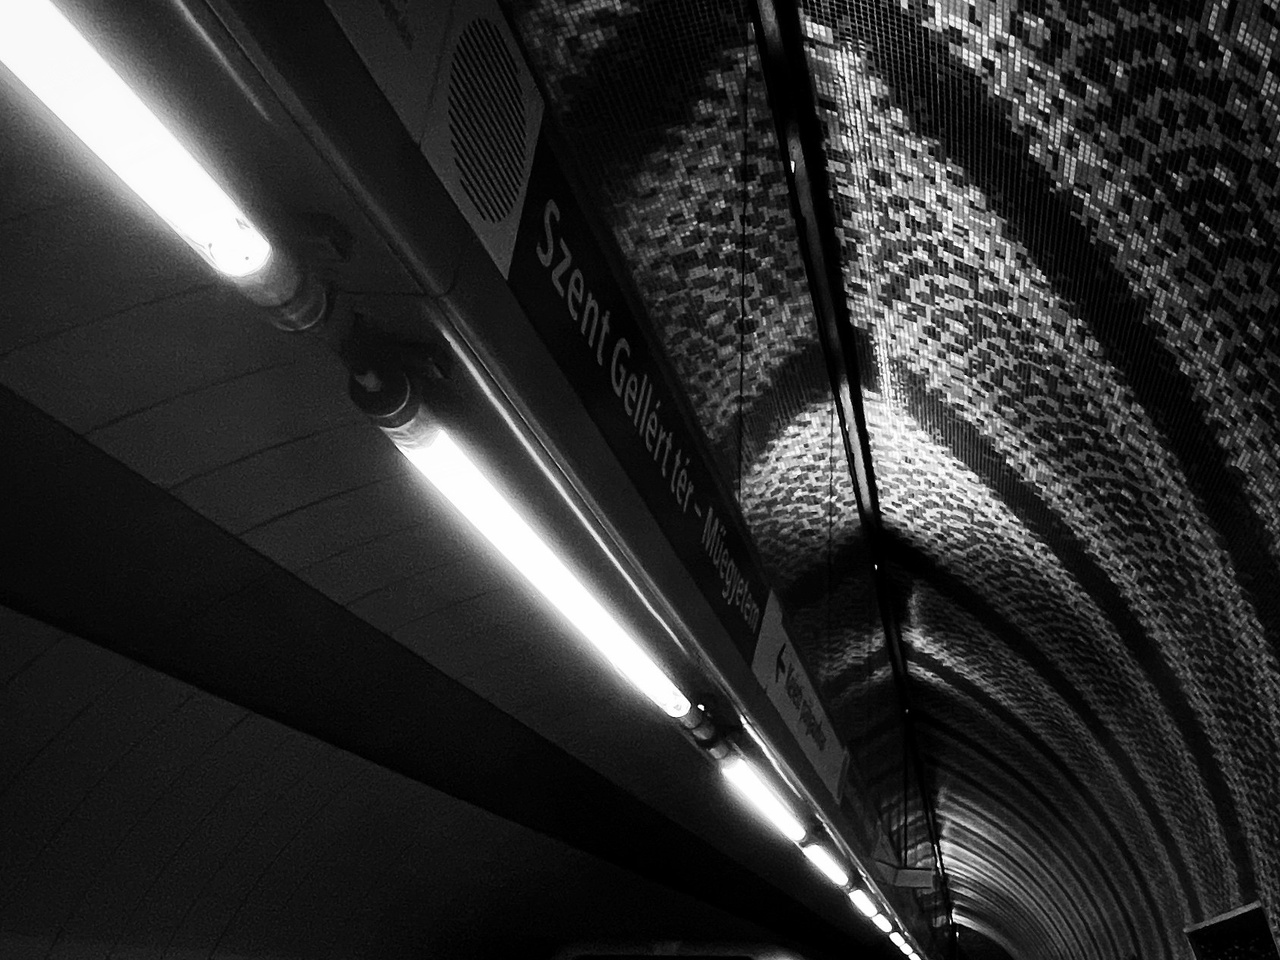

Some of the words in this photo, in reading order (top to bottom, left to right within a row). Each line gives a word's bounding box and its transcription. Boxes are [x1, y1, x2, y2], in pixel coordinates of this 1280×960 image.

[535, 199, 611, 366] Szent
[610, 337, 673, 478] Gellért
[670, 449, 694, 513] tér
[701, 505, 760, 634] Műegyetem
